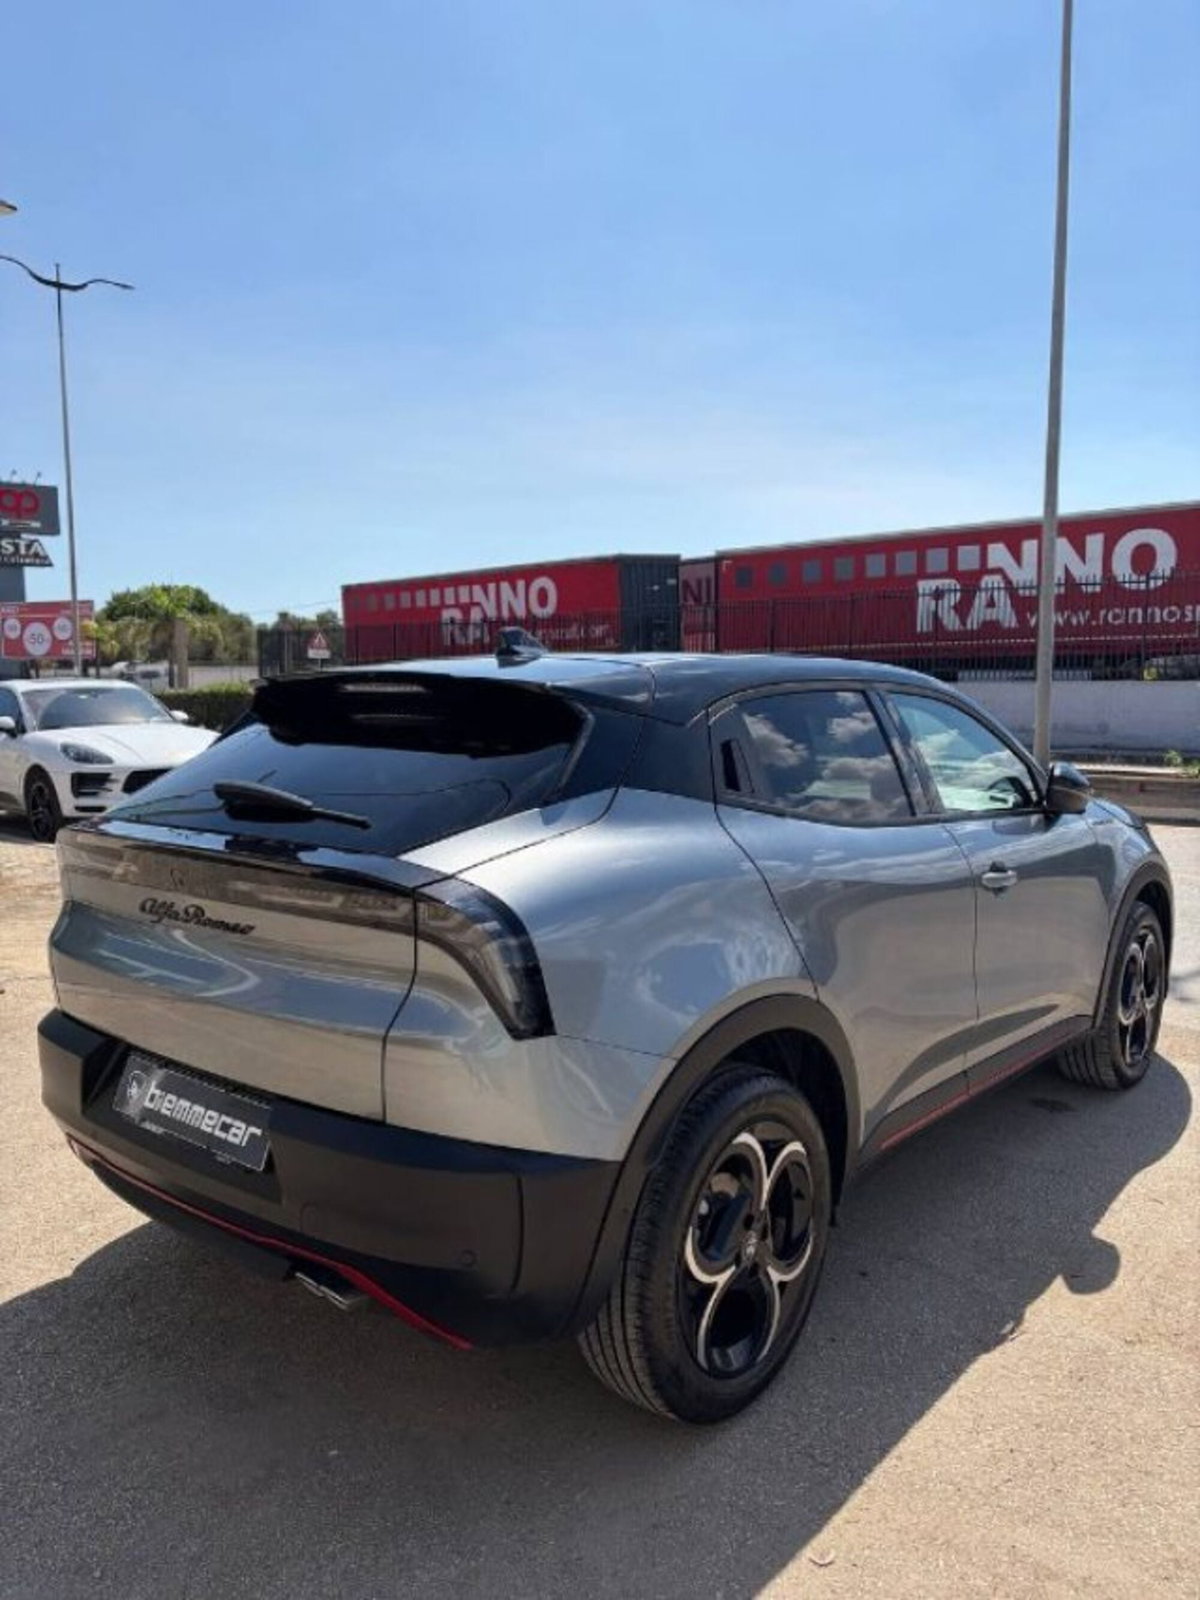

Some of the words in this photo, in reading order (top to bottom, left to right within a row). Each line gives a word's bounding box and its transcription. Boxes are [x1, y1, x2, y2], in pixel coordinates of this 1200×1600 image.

[440, 576, 558, 646] RANNO
[917, 528, 1178, 633] RANNO
[1027, 604, 1200, 628] www.rannos
[143, 1080, 262, 1147] biemmecar
